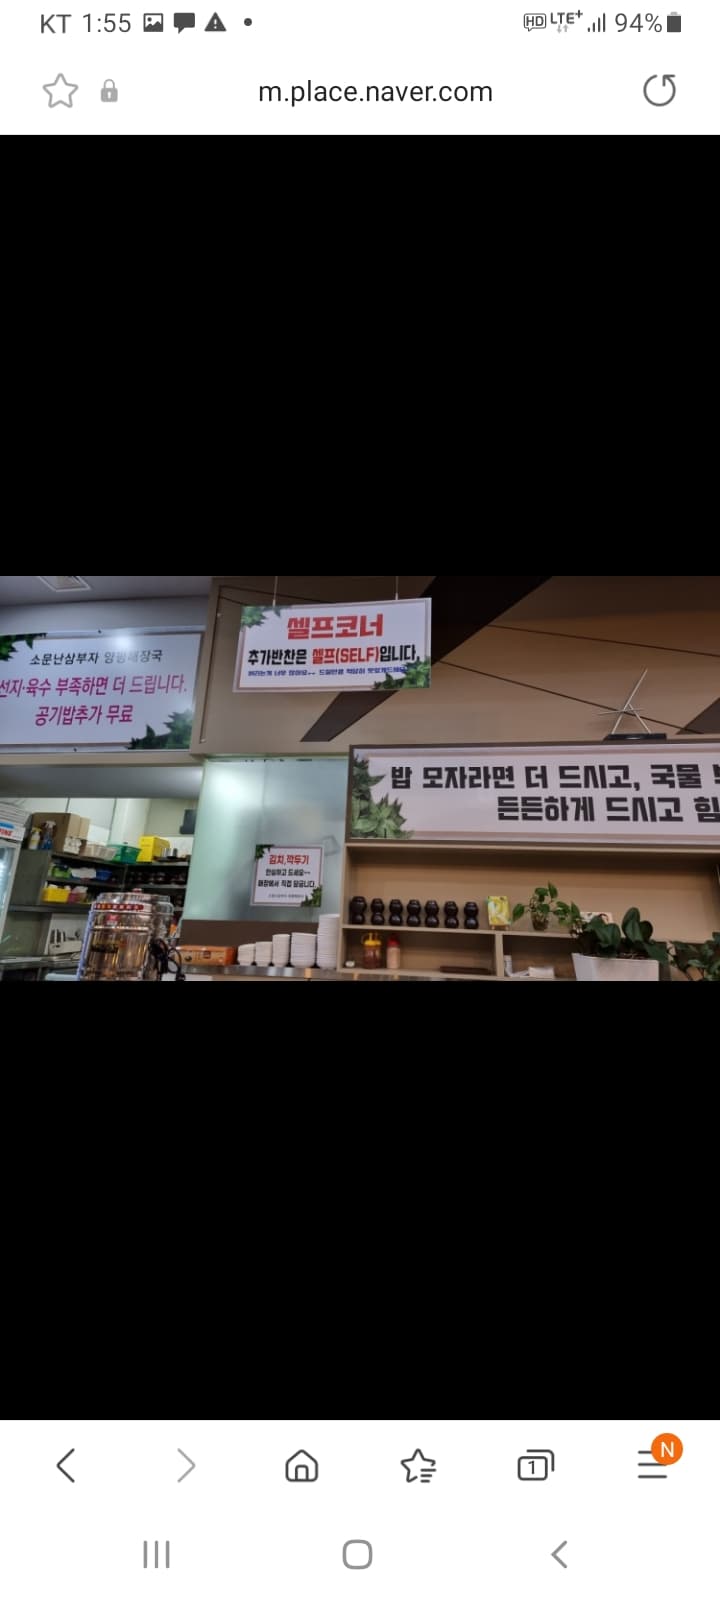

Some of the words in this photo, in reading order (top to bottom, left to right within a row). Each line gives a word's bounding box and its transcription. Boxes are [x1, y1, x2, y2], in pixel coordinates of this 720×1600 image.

[40, 14, 72, 34] KT
[82, 13, 131, 34] 1:55
[614, 12, 662, 34] 94%
[258, 80, 493, 106] m.place.naver.com
[287, 613, 384, 640] 셀프코너
[29, 650, 99, 666] 소문난삼부자
[247, 647, 307, 666] 추가반찬은
[55, 676, 108, 696] 부족하면
[113, 675, 126, 695] 더
[129, 674, 187, 694] 드립니다.
[35, 705, 102, 726] 공기밥추가
[105, 704, 133, 724] 무료
[391, 765, 412, 789] 밥
[422, 765, 515, 790] 모자라면
[525, 765, 547, 789] 더
[559, 764, 640, 791] 드시고,
[650, 763, 703, 789] 국물
[497, 795, 595, 822] 든든하게
[605, 796, 684, 822] 드시고
[693, 796, 720, 823] 힘
[528, 1460, 536, 1475] 1
[660, 1441, 674, 1459] N
